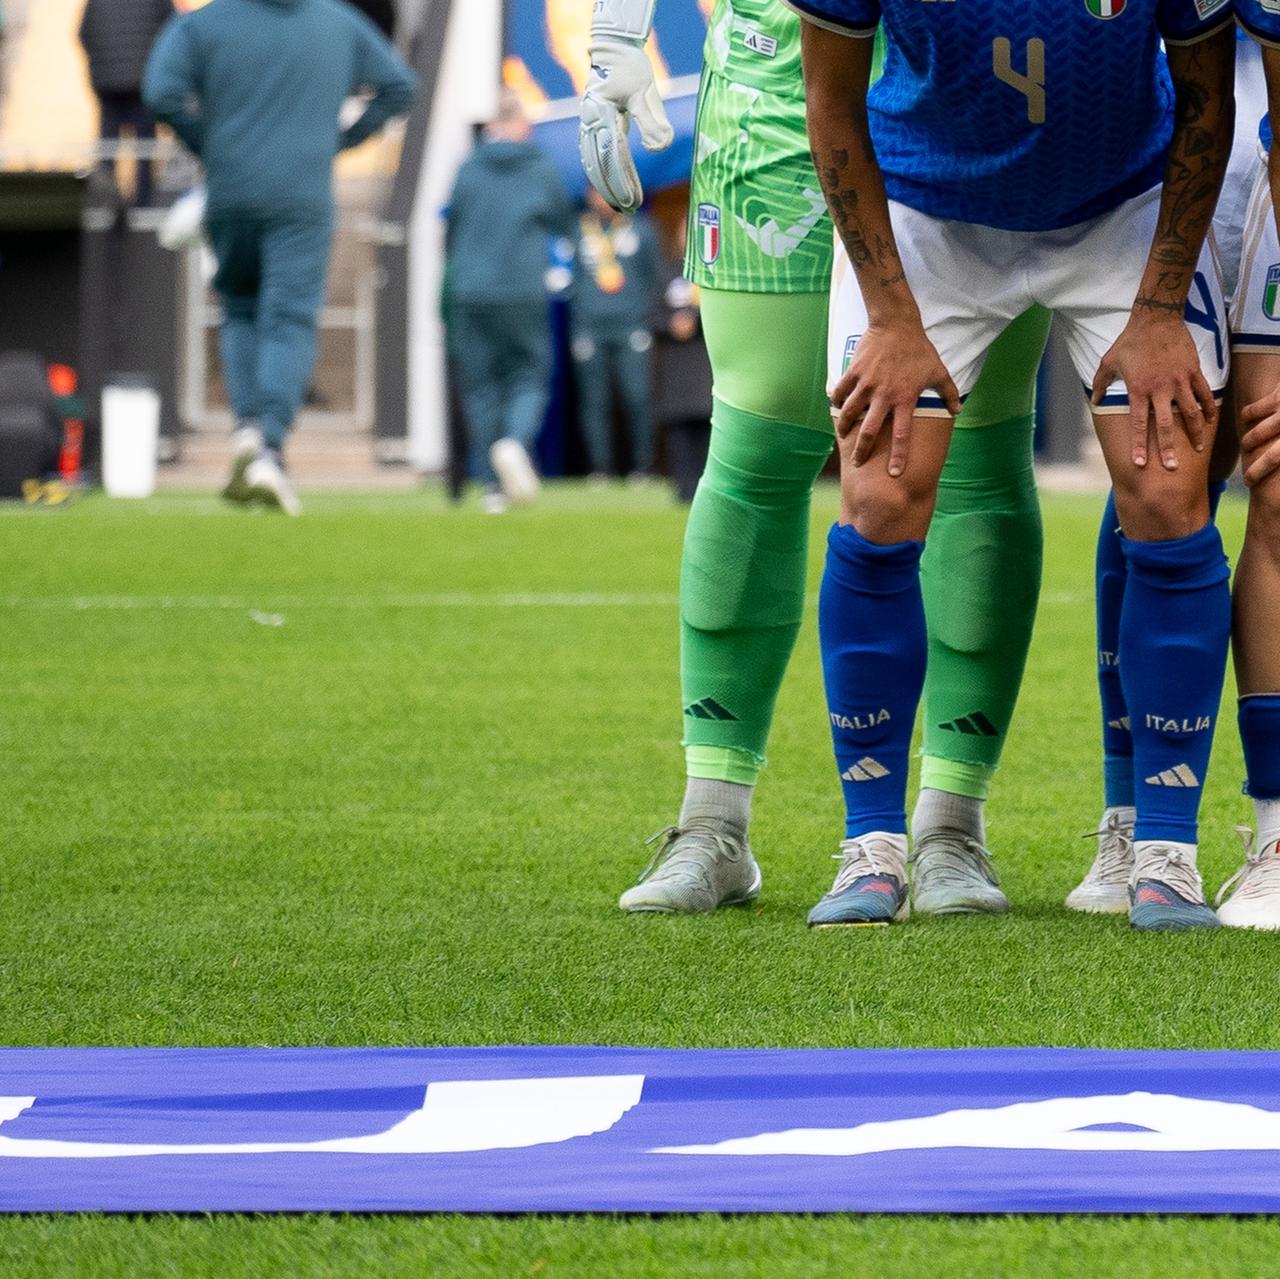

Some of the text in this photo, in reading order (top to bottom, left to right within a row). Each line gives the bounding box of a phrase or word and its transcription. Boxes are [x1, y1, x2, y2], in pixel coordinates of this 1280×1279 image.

[991, 36, 1046, 124] 4
[698, 207, 718, 221] ITALIA
[830, 708, 892, 732] ITALIA
[1145, 713, 1211, 734] ITALIA
